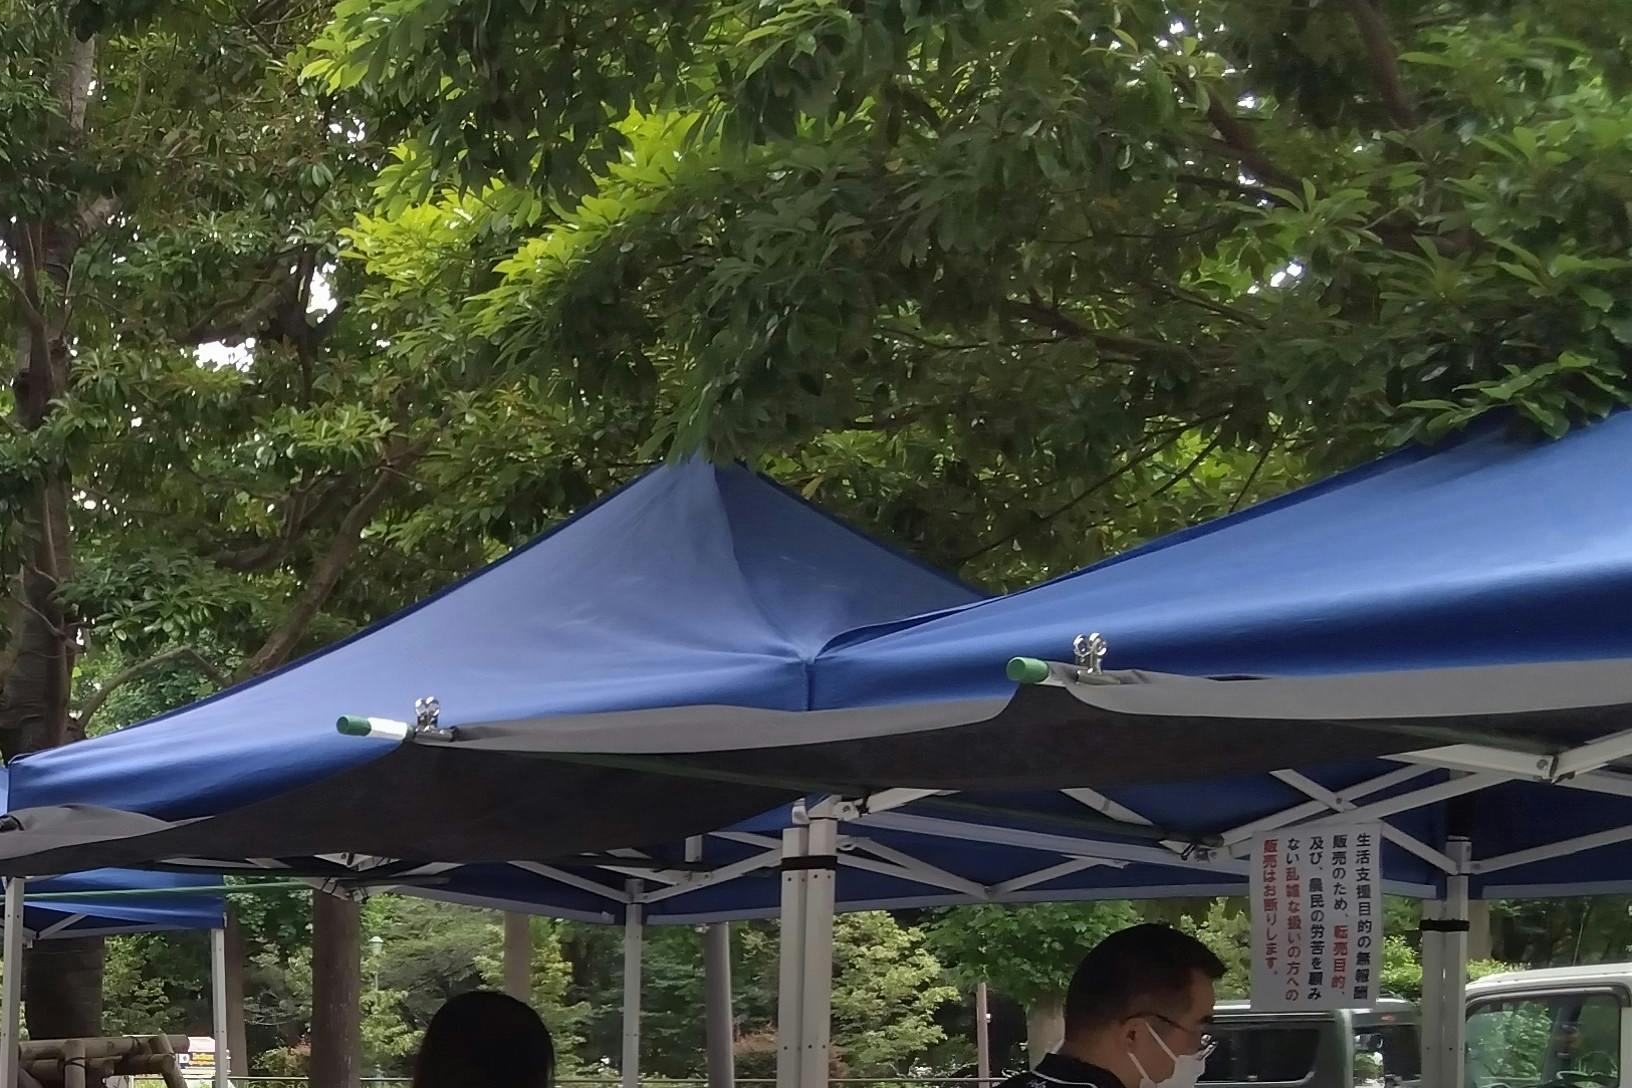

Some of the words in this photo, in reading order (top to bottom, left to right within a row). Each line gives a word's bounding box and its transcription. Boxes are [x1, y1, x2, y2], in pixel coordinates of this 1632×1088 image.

[1263, 839, 1279, 975] 販売はお断りします。
[1285, 838, 1302, 1002] ない乱雑な扱いの方への
[1354, 832, 1373, 1001] 生活支援目的の無報酬
